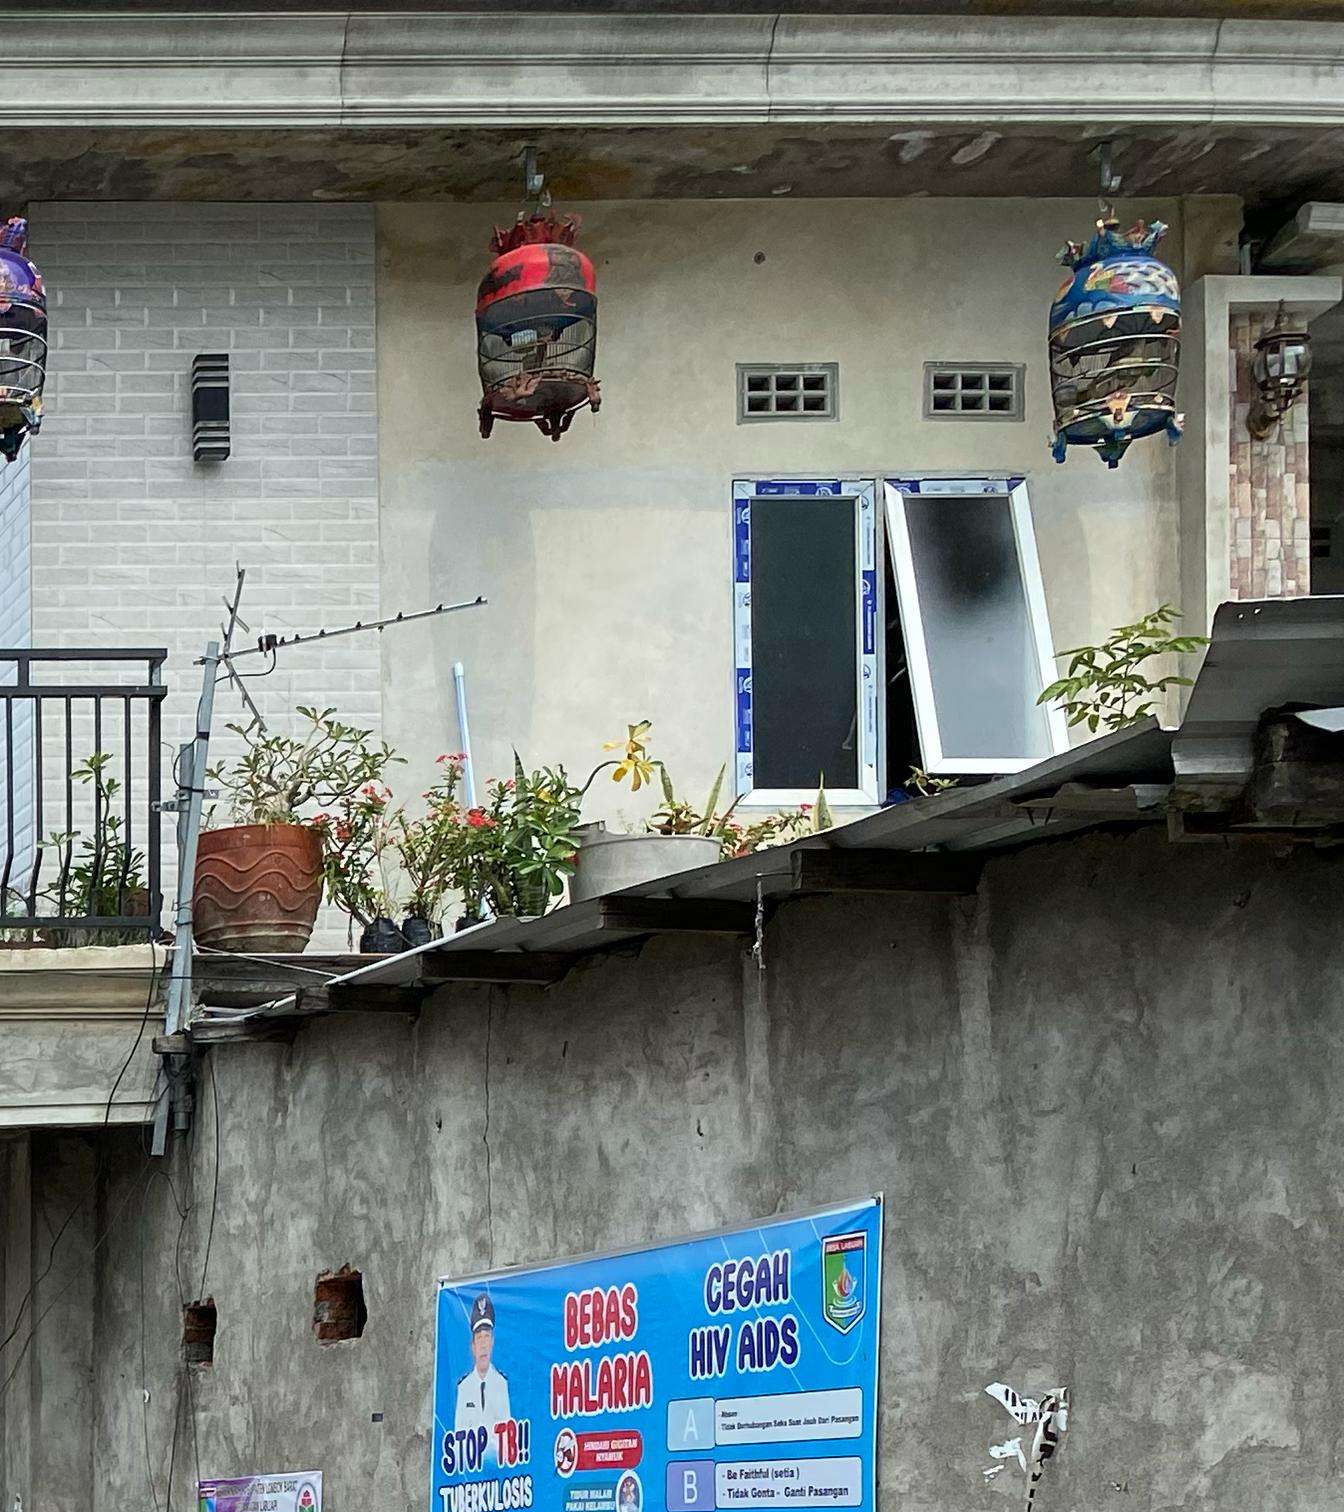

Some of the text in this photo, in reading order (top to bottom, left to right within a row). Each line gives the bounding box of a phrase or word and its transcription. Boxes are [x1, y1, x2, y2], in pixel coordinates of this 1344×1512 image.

[565, 1252, 790, 1348] BEBAS CEGAH
[551, 1319, 799, 1417] MALARIA HIV AIDS
[683, 1407, 699, 1441] A
[443, 1419, 530, 1475] STOP TB!!
[683, 1470, 698, 1504] B
[726, 1469, 738, 1480] Be
[739, 1468, 769, 1480] Faithful
[727, 1488, 749, 1498] Tidak
[783, 1486, 807, 1497] Ganti
[808, 1485, 849, 1498] Pasangan
